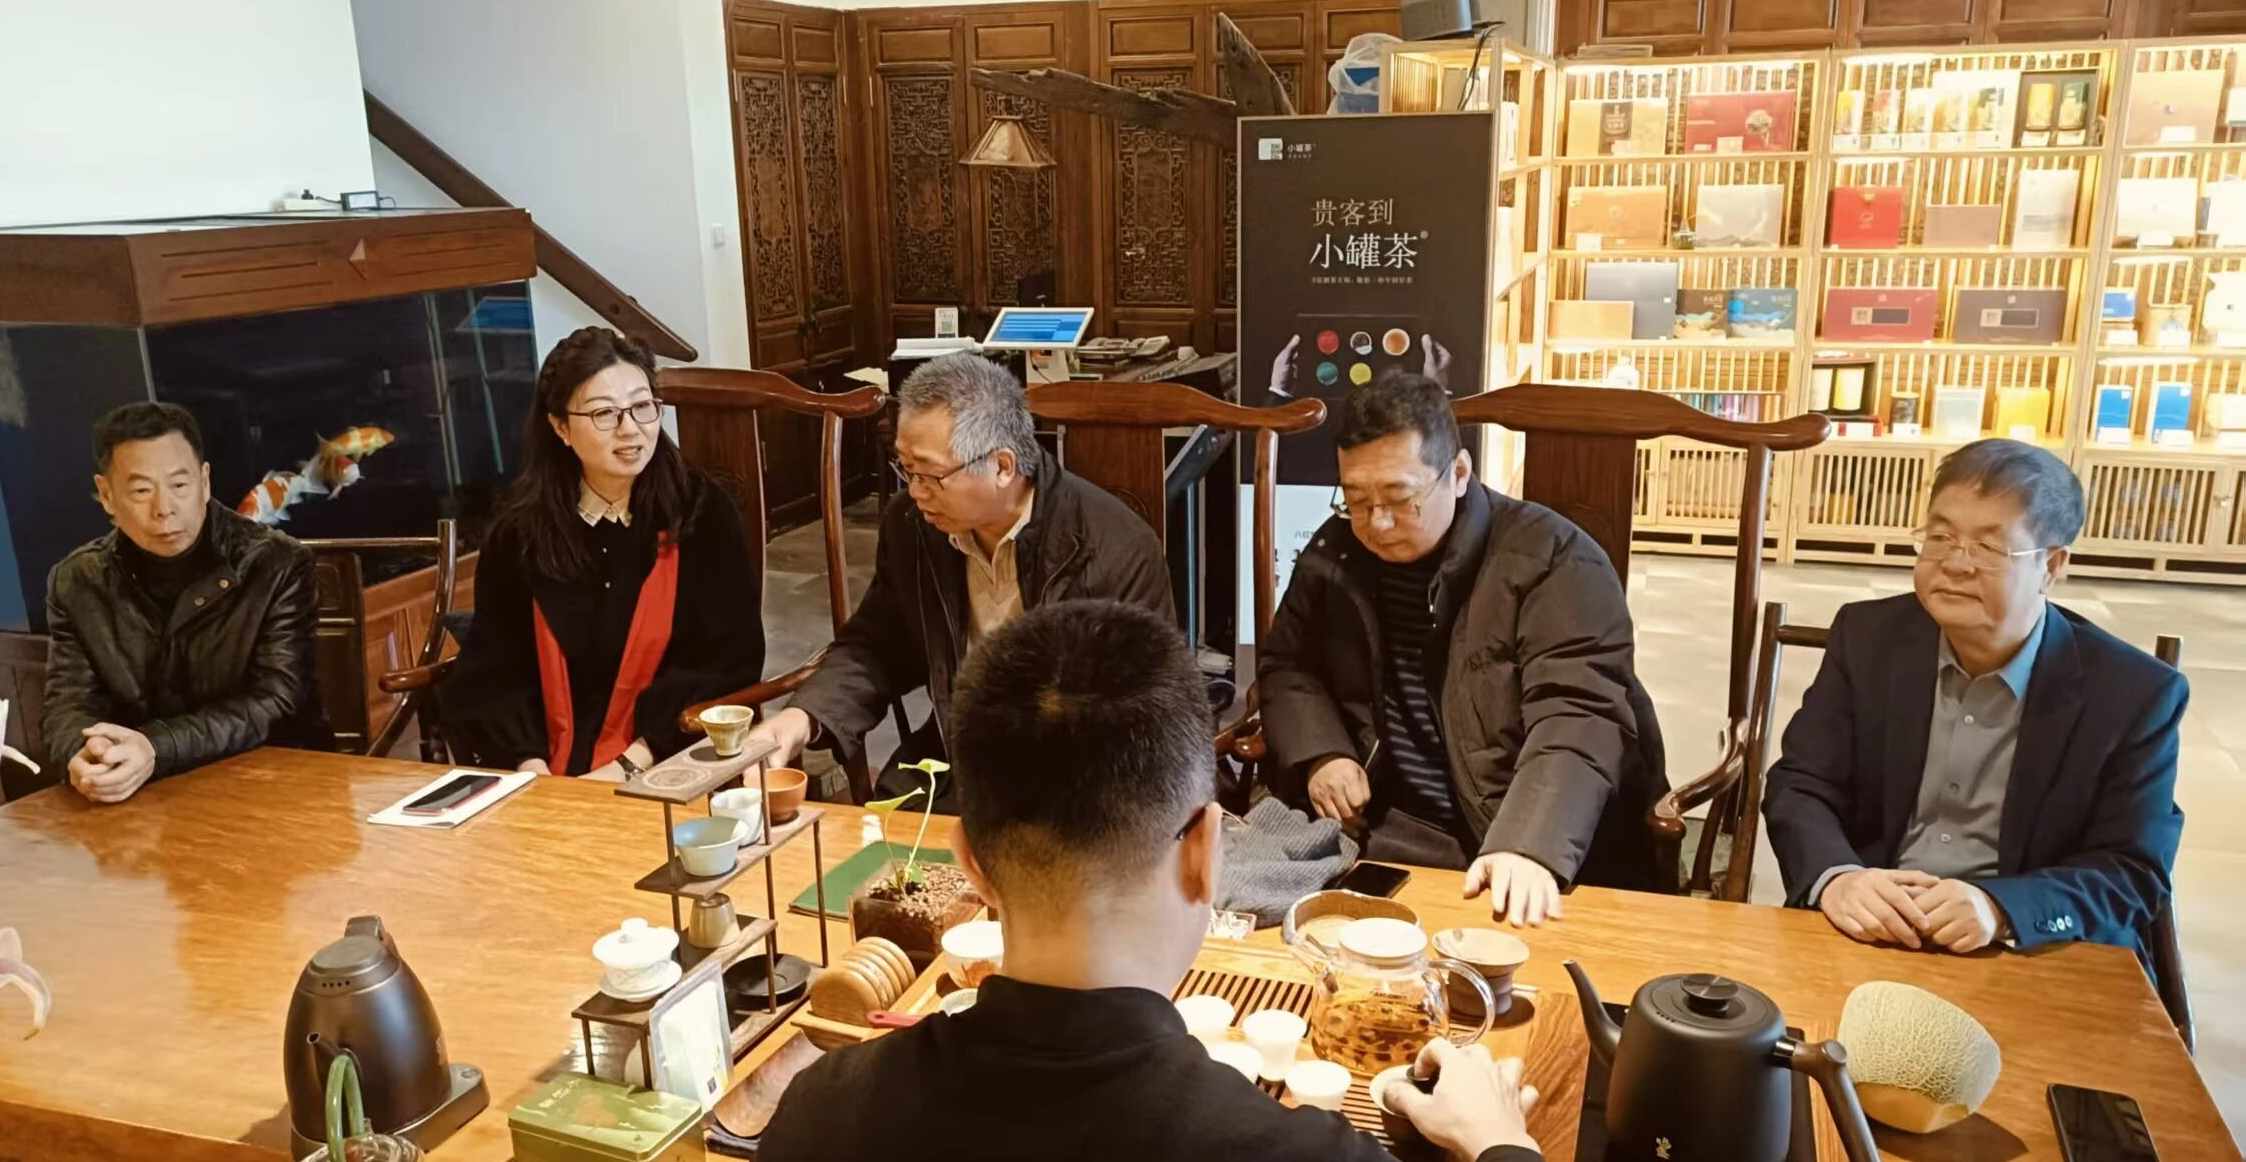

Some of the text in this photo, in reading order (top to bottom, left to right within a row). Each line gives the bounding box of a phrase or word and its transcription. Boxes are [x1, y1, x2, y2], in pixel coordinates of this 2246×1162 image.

[1311, 198, 1394, 227] 贵客到
[1308, 232, 1419, 270] 小罐茶
